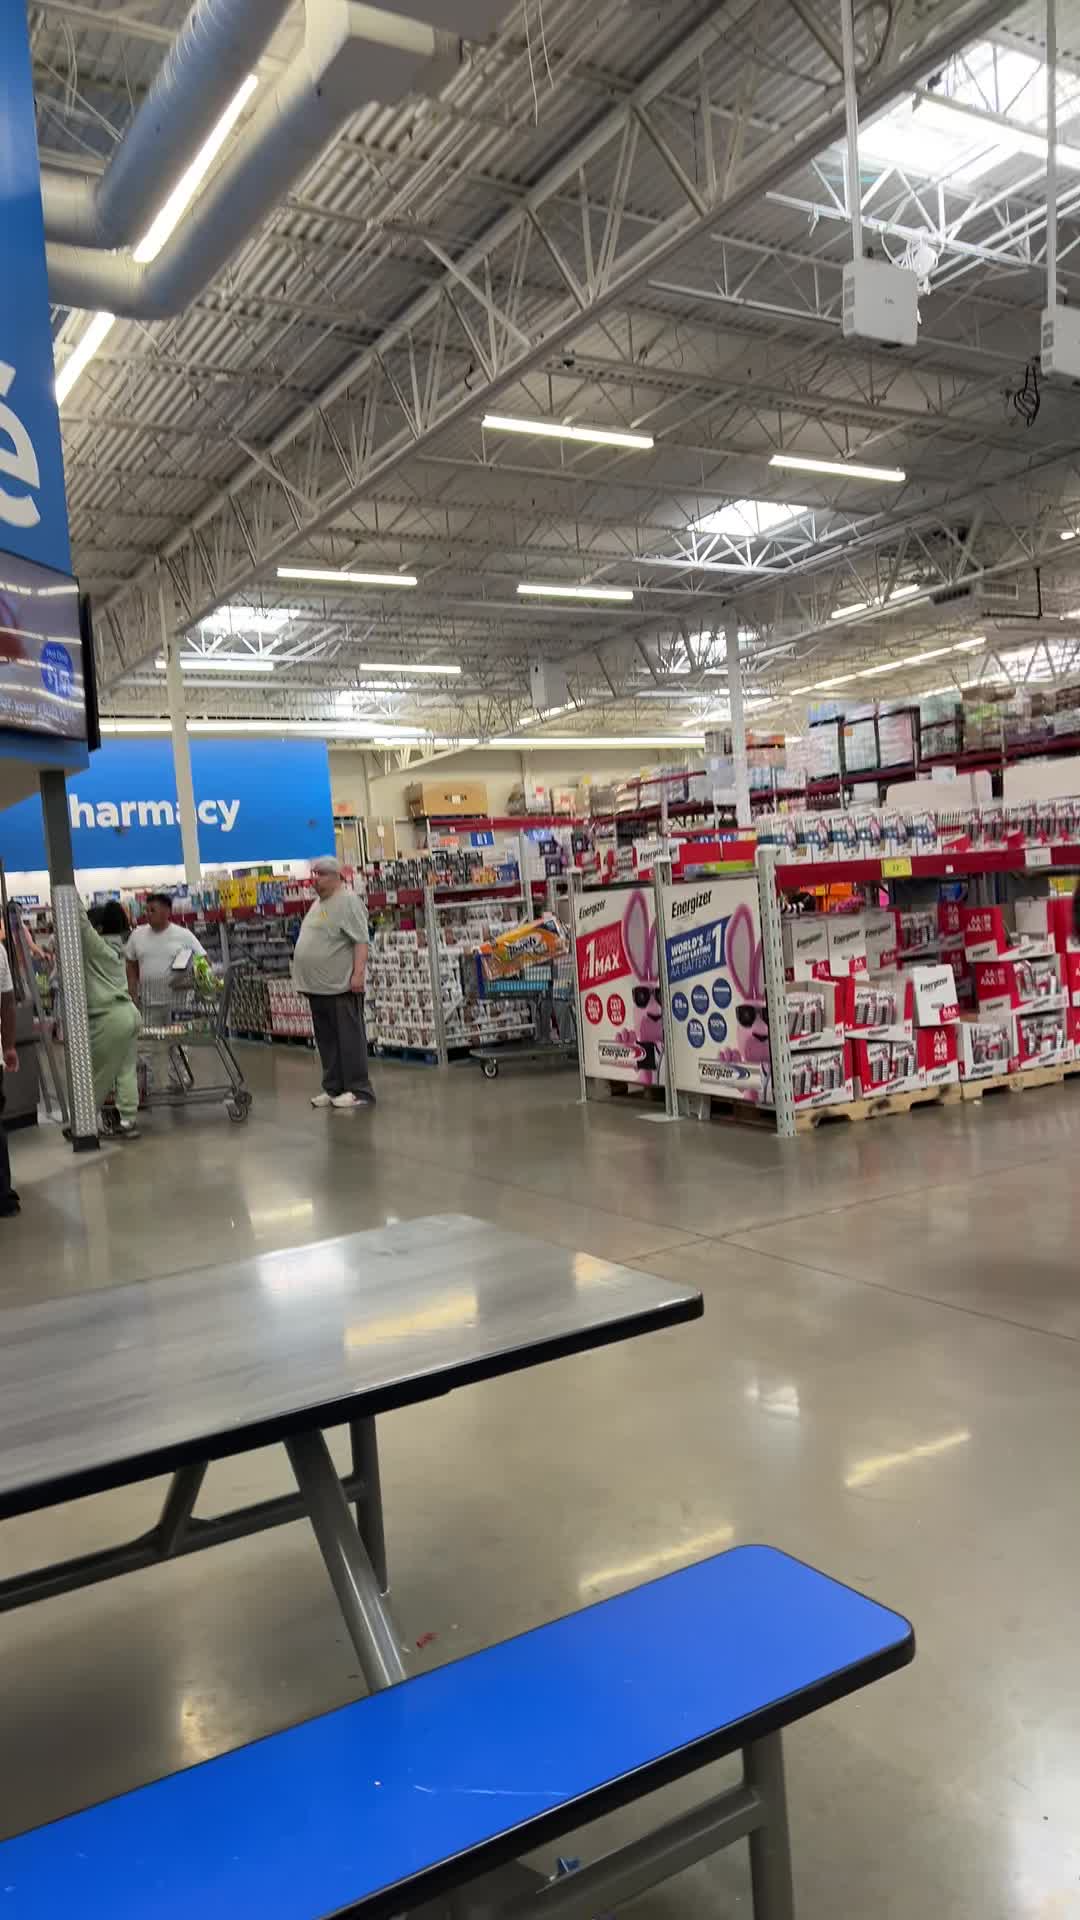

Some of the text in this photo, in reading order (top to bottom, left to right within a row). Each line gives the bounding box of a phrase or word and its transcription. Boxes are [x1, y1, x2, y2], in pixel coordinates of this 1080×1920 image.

[69, 793, 240, 832] harmcy
[673, 890, 712, 919] Energizer
[595, 952, 620, 977] MAX
[934, 1031, 947, 1041] AA
[701, 1064, 734, 1080] Energizer
